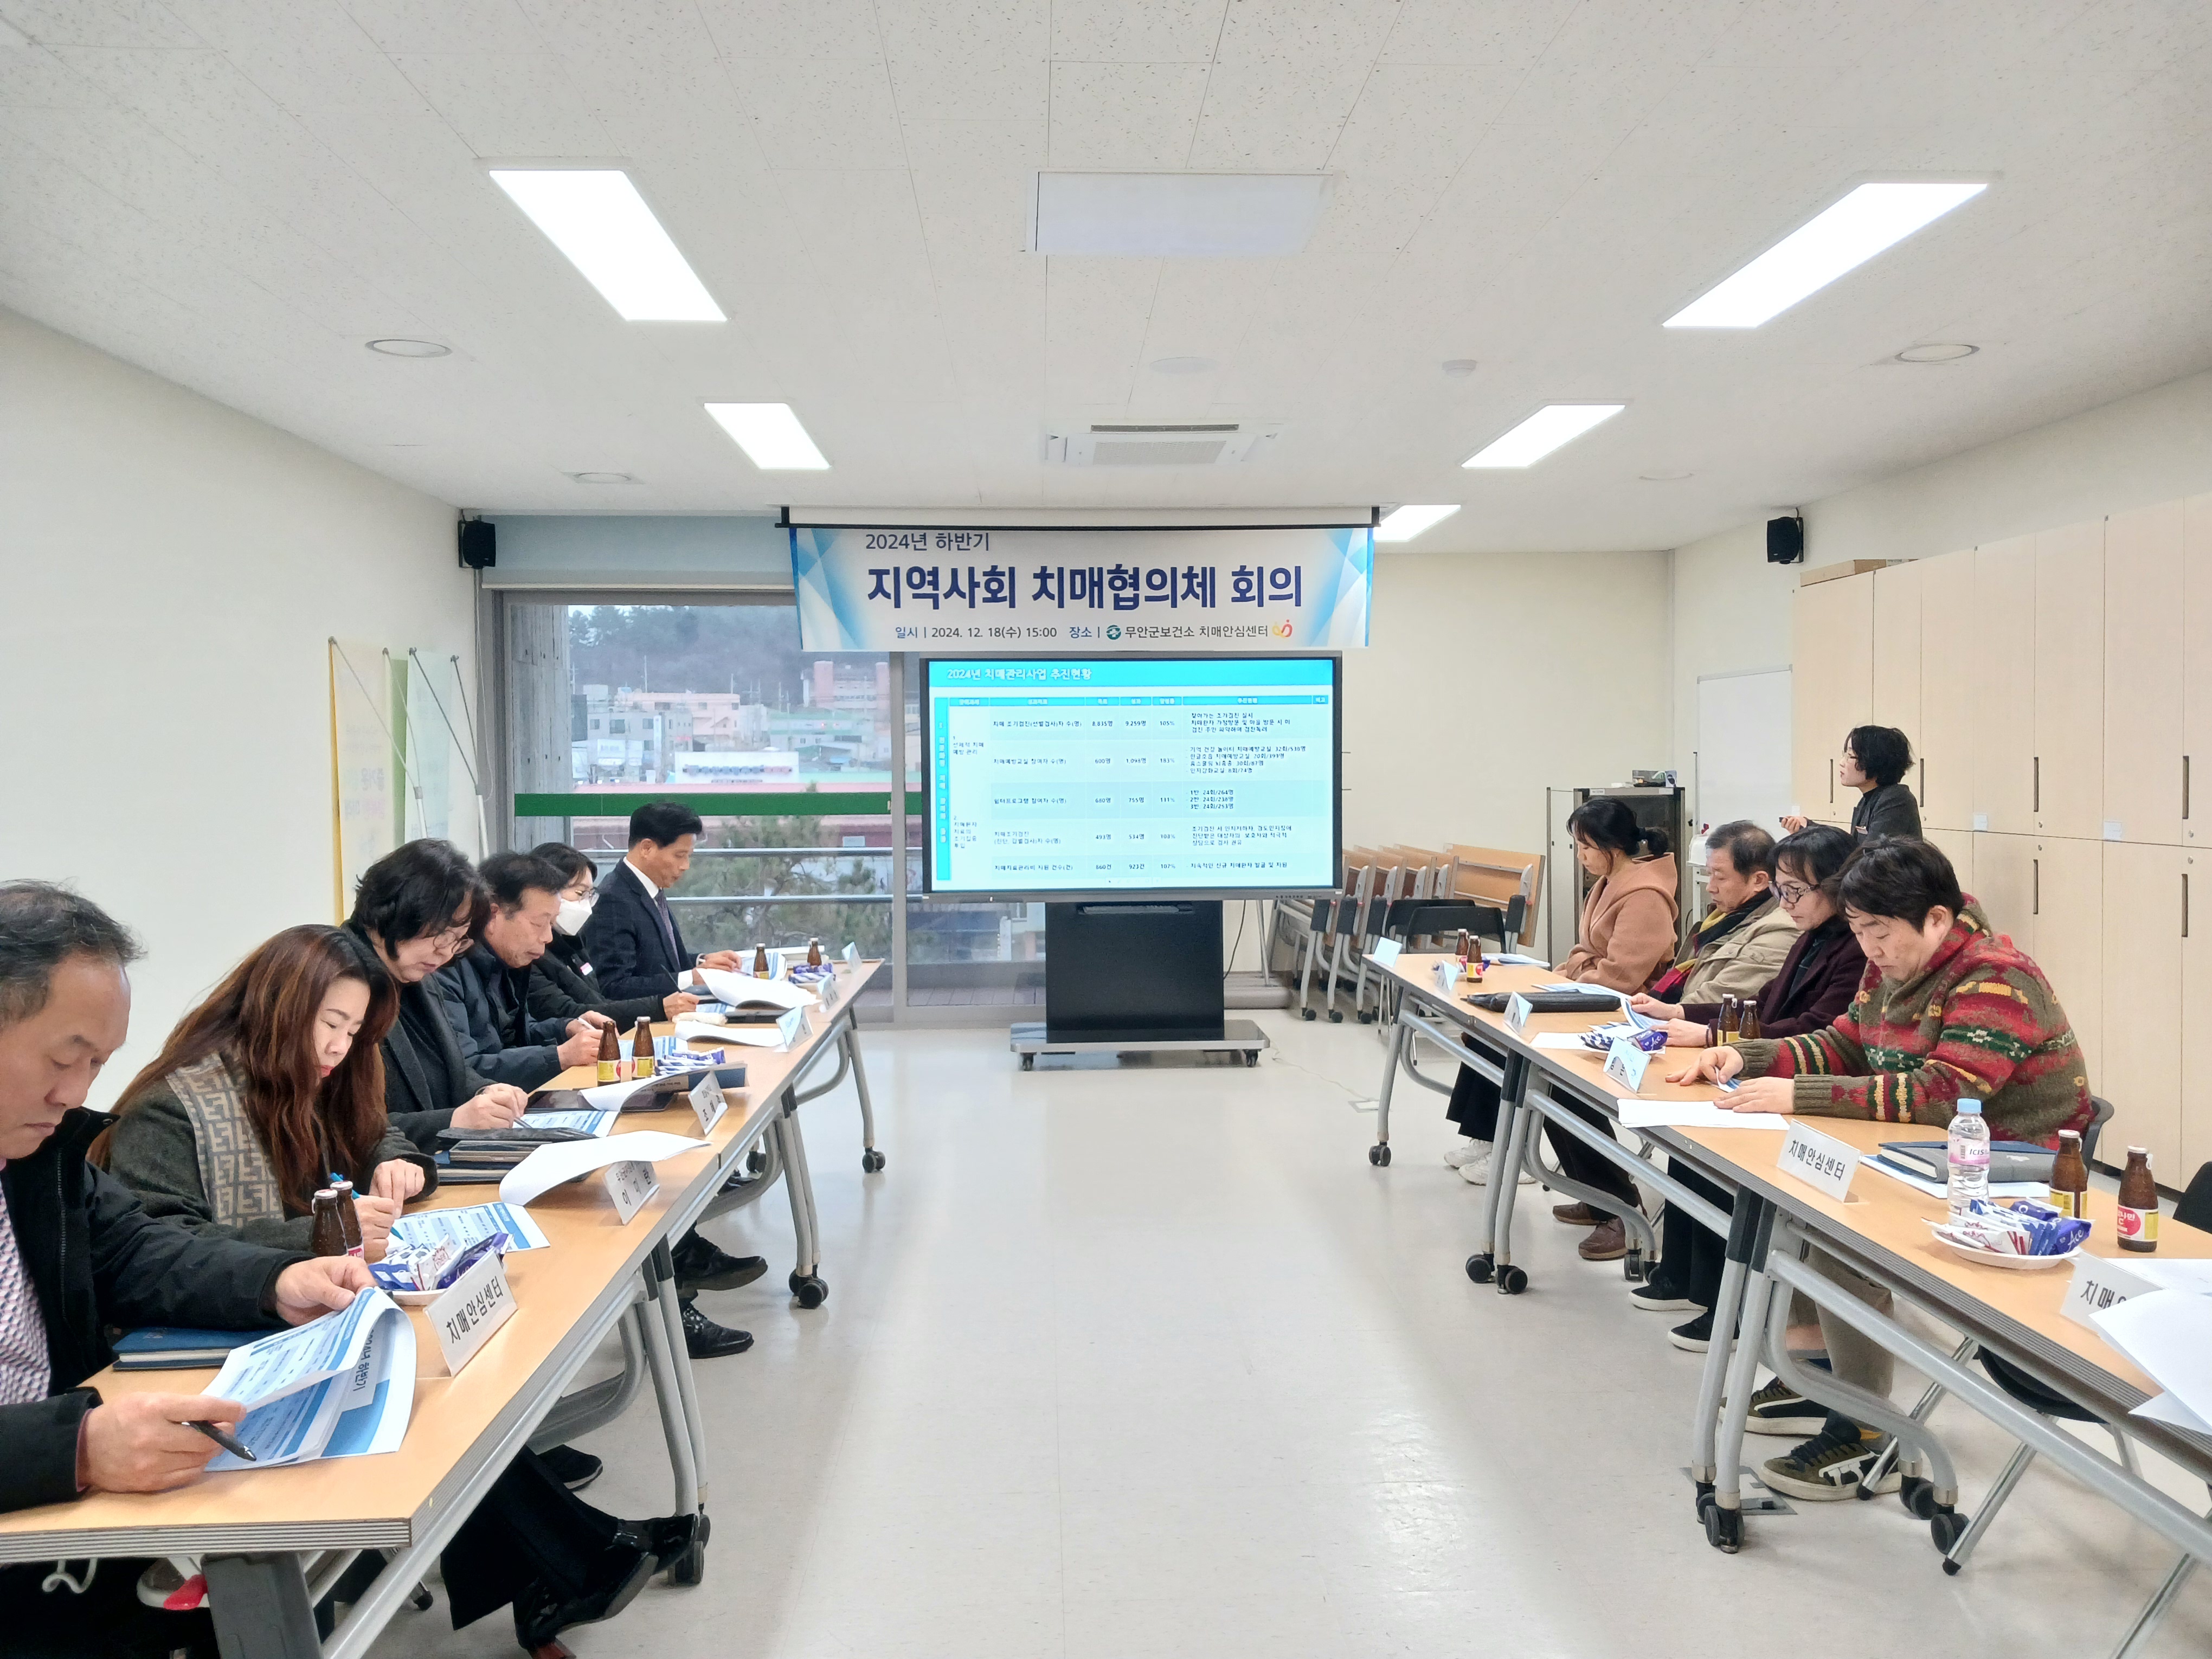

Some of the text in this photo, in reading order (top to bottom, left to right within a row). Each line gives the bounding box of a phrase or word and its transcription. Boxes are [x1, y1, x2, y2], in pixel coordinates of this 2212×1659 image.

[866, 532, 989, 551] 2024년 하반기
[867, 564, 1302, 611] 지역사회 치매협의체 회의
[895, 627, 918, 639] 일시
[931, 627, 962, 638] 2024.
[968, 627, 983, 638] 12.
[988, 627, 1021, 639] 18(수)
[1026, 627, 1057, 638] 15:00
[1069, 627, 1092, 639] 장소
[1125, 626, 1195, 639] 무안군보건소
[1199, 625, 1268, 638] 치매안심센터
[947, 668, 1092, 680] 2024년 치매관리사업 추진현황
[1789, 1139, 1846, 1181] 치매안심센터
[2067, 1229, 2084, 1252] Ace
[446, 1275, 504, 1345] 치매안심센터
[352, 1362, 370, 1392] 하반기
